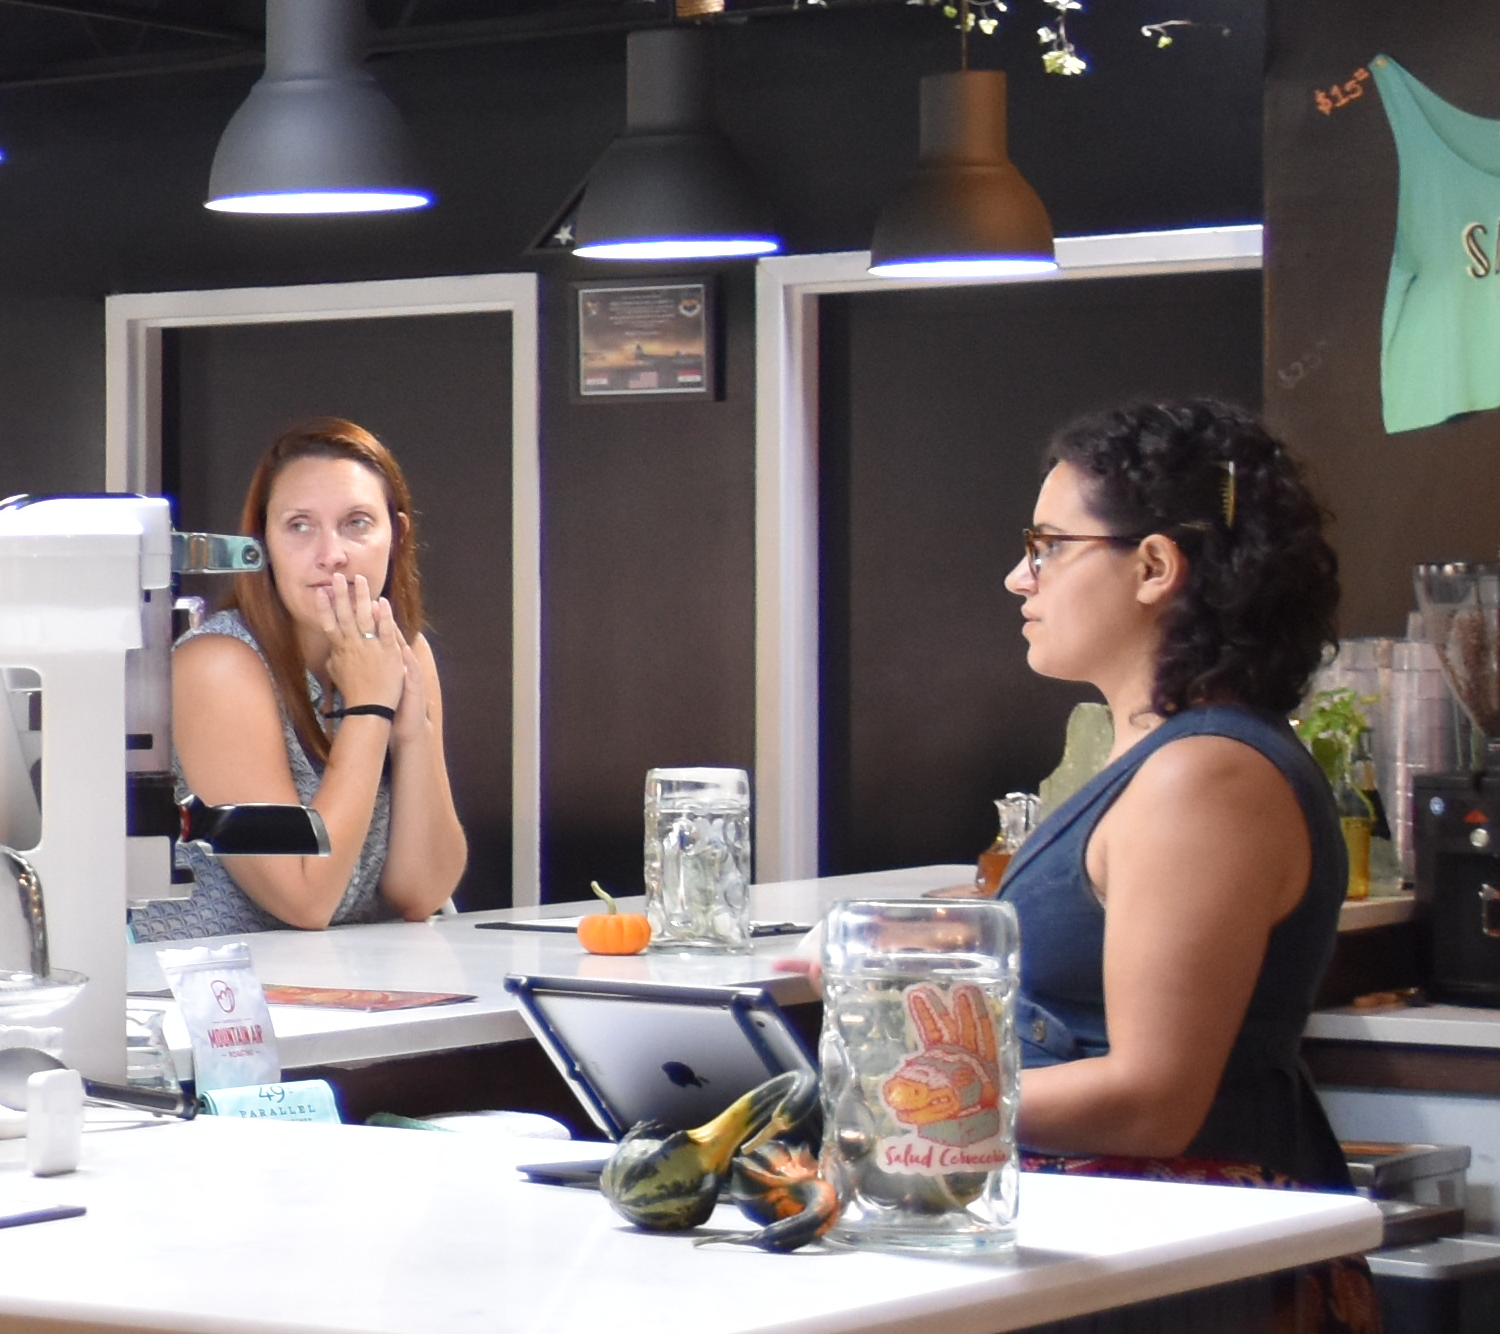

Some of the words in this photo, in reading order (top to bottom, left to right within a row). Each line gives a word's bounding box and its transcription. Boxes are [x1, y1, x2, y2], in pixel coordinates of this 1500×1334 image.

[1462, 217, 1500, 279] S
[207, 1027, 250, 1048] MOUNTAIN
[251, 1024, 264, 1044] AIR
[239, 1104, 317, 1119] PARALLEL
[885, 1143, 933, 1168] Salud
